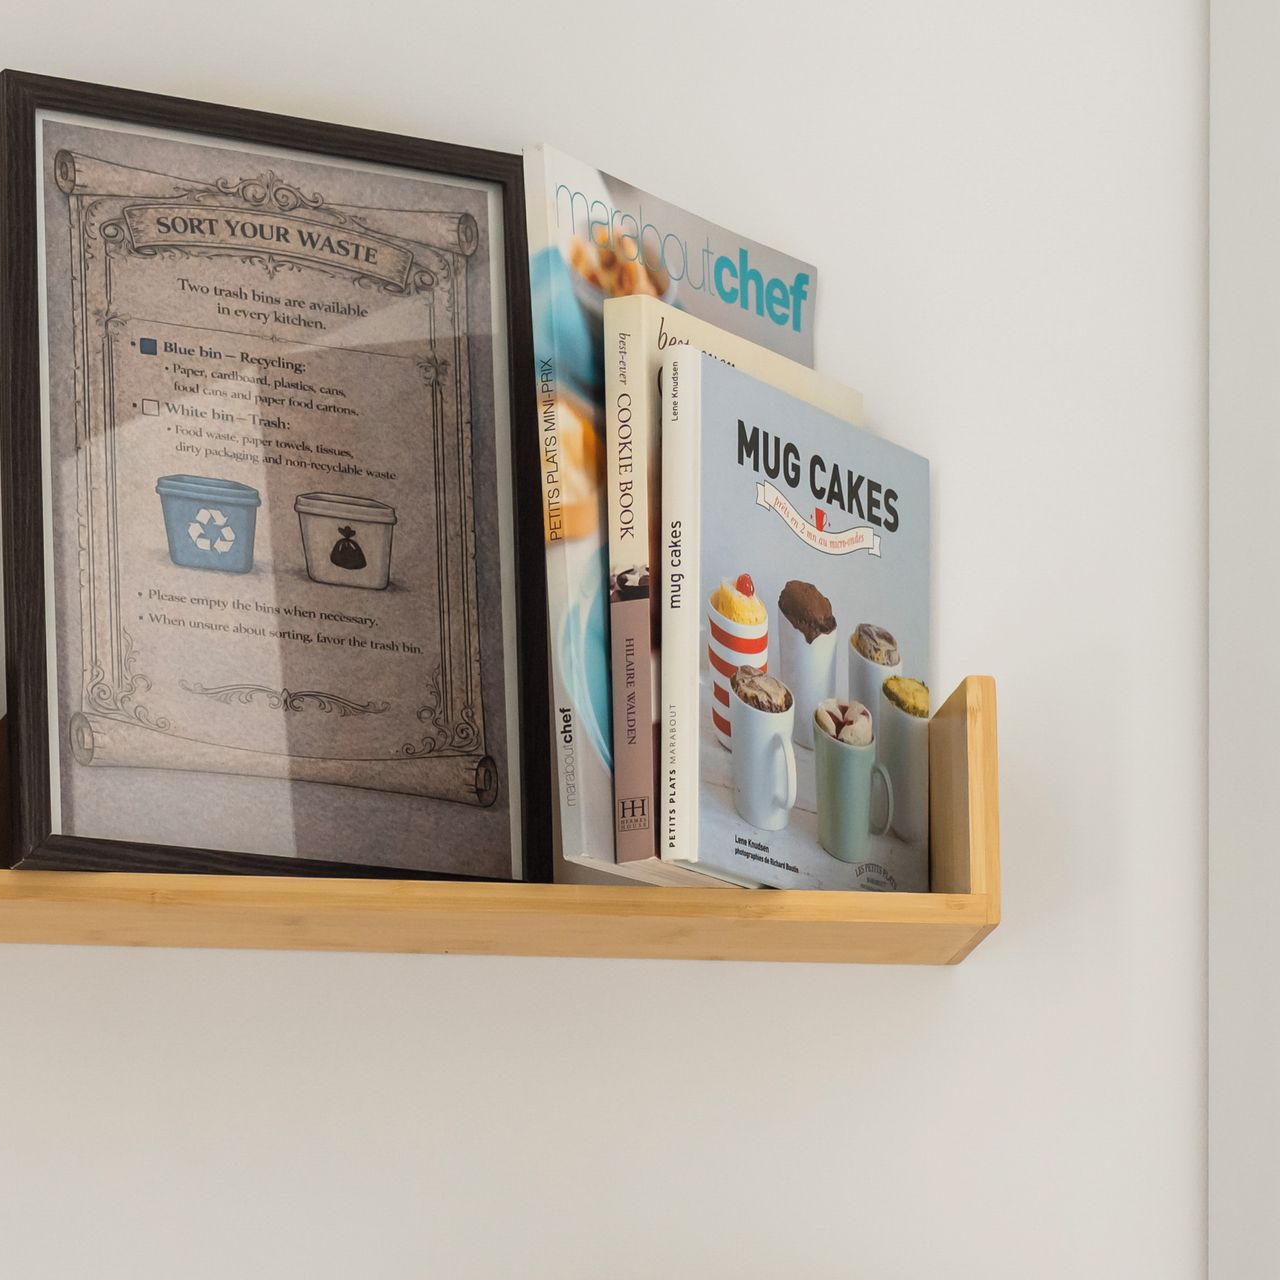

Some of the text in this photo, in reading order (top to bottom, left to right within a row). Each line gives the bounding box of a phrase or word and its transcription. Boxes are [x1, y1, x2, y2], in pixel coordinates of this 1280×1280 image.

[156, 216, 379, 265] SORT YOUR WASTE
[177, 278, 369, 318] Two trash bins are available
[217, 303, 327, 331] in every kitchen.
[163, 341, 195, 357] Blue
[199, 345, 222, 360] bin
[240, 351, 306, 374] Recycling:
[173, 363, 347, 398] Paper, cardboard, plastics, cans,
[174, 382, 359, 417] food cans and paper food cartons.
[671, 361, 679, 422] Lene Knudsen
[164, 402, 208, 418] White
[212, 406, 234, 422] bin
[250, 413, 291, 430] Trash:
[175, 425, 354, 459] Food waste, paper towels, tissues,
[540, 357, 562, 541] PETITS PLATS MINI-PRIX
[616, 332, 635, 540] best-ever COOKIE BOOK
[175, 441, 201, 456] dirty
[204, 446, 260, 464] packaging
[262, 453, 282, 465] and
[285, 458, 363, 476] non-recyclable
[738, 419, 900, 533] MUG CAKES
[800, 522, 805, 535] 2
[668, 520, 684, 609] mug cakes
[148, 588, 378, 627] Please empty the bins when necessary.
[148, 612, 186, 627] When
[189, 619, 230, 632] unsure
[232, 622, 266, 637] about
[316, 631, 344, 646] favor
[348, 634, 368, 648] the
[370, 637, 399, 652] trash
[402, 641, 424, 655] bin.
[625, 638, 637, 745] HILAIRE WALDEN
[668, 703, 677, 848] PETITS PLATS MARABOUT
[734, 833, 748, 847] Lene
